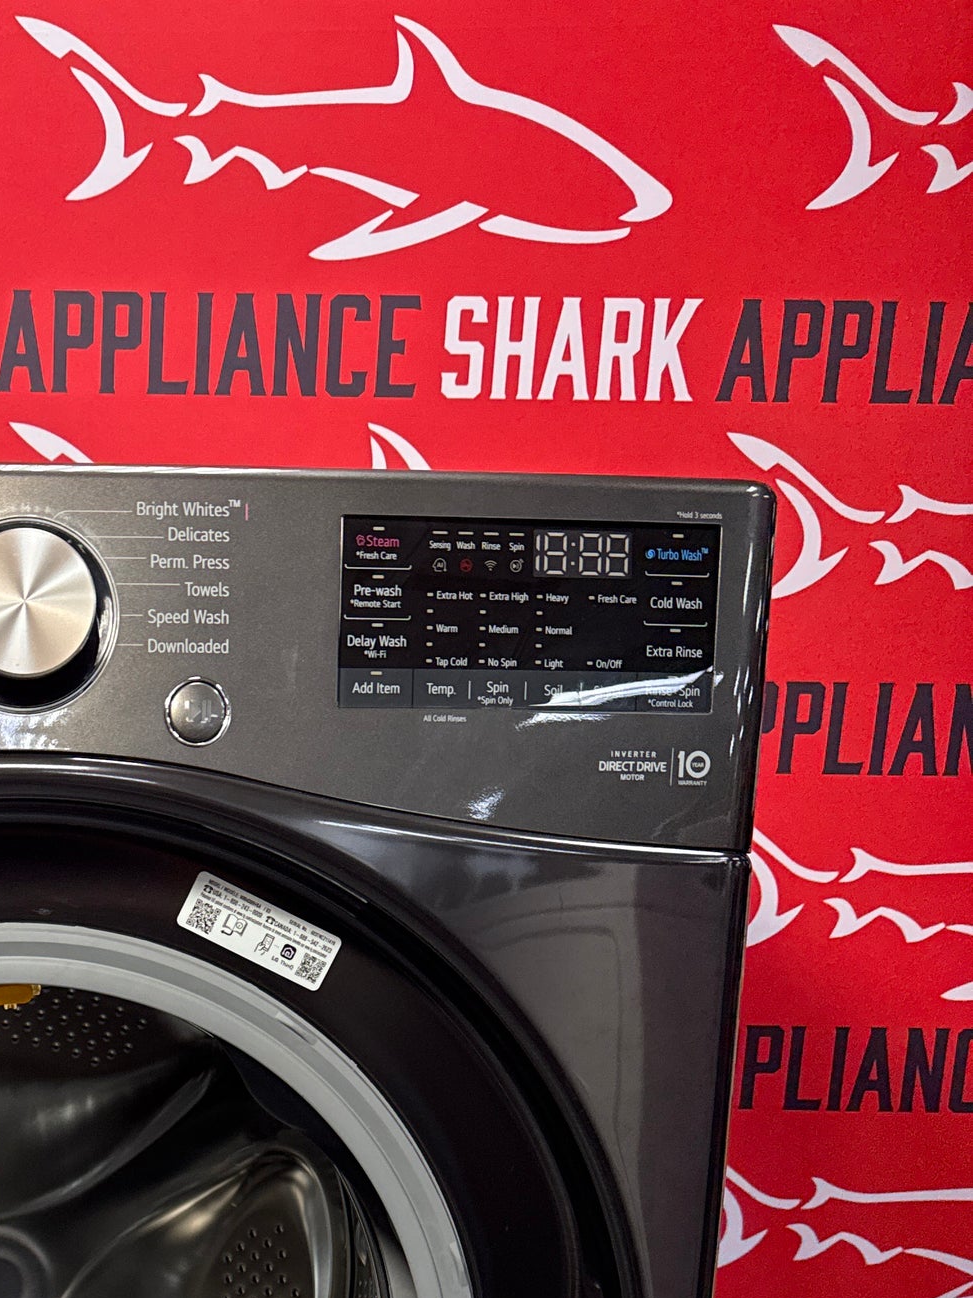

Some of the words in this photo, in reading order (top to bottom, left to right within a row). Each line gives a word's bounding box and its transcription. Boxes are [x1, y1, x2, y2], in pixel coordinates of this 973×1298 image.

[441, 296, 704, 402] SHARK
[137, 502, 178, 520] Bright
[700, 512, 723, 520] seconds
[168, 527, 230, 542] Delicates
[367, 535, 399, 548] Steam
[429, 541, 451, 551] Sensing
[457, 542, 475, 550] Wash
[481, 542, 501, 550] Rinse
[509, 542, 525, 551] Spin
[381, 552, 397, 560] Care
[657, 548, 679, 560] Turbo
[151, 554, 189, 569] Perm.
[193, 555, 229, 569] Press
[185, 582, 229, 597] Towels
[354, 584, 401, 597] Pre-wash
[437, 591, 457, 600] Extra
[459, 592, 473, 600] Hot
[489, 592, 509, 600] Extra
[511, 592, 529, 603] High
[545, 593, 569, 604] Heavy
[598, 594, 618, 603] Fresh
[619, 595, 637, 604] Care
[383, 600, 401, 608] Start
[650, 597, 673, 608] Cold
[675, 598, 703, 610] Wash
[147, 608, 189, 627] Speed
[194, 610, 229, 624] Wash
[436, 624, 458, 633] Warm
[489, 625, 519, 634] Medium
[545, 626, 573, 636] Normal
[147, 638, 229, 654] Downloaded
[347, 635, 376, 649] Delay
[379, 636, 407, 648] Wash
[646, 645, 673, 657] Extra
[676, 646, 703, 658] Rinse
[436, 658, 448, 668] Tap
[451, 658, 468, 666] Cold
[487, 658, 499, 666] No
[501, 658, 517, 668] Spin
[544, 659, 563, 670] Light
[595, 660, 623, 670] On/Off
[352, 682, 373, 694] Add
[377, 682, 401, 694] Item
[427, 683, 457, 698] Temp.
[487, 681, 509, 695] Spin
[544, 684, 563, 696] Soil
[497, 696, 513, 706] Only
[678, 700, 693, 708] Lock
[611, 750, 657, 758] INVERTER
[599, 761, 635, 772] DIRECT
[637, 762, 667, 772] DRIVE
[678, 750, 711, 778] 10
